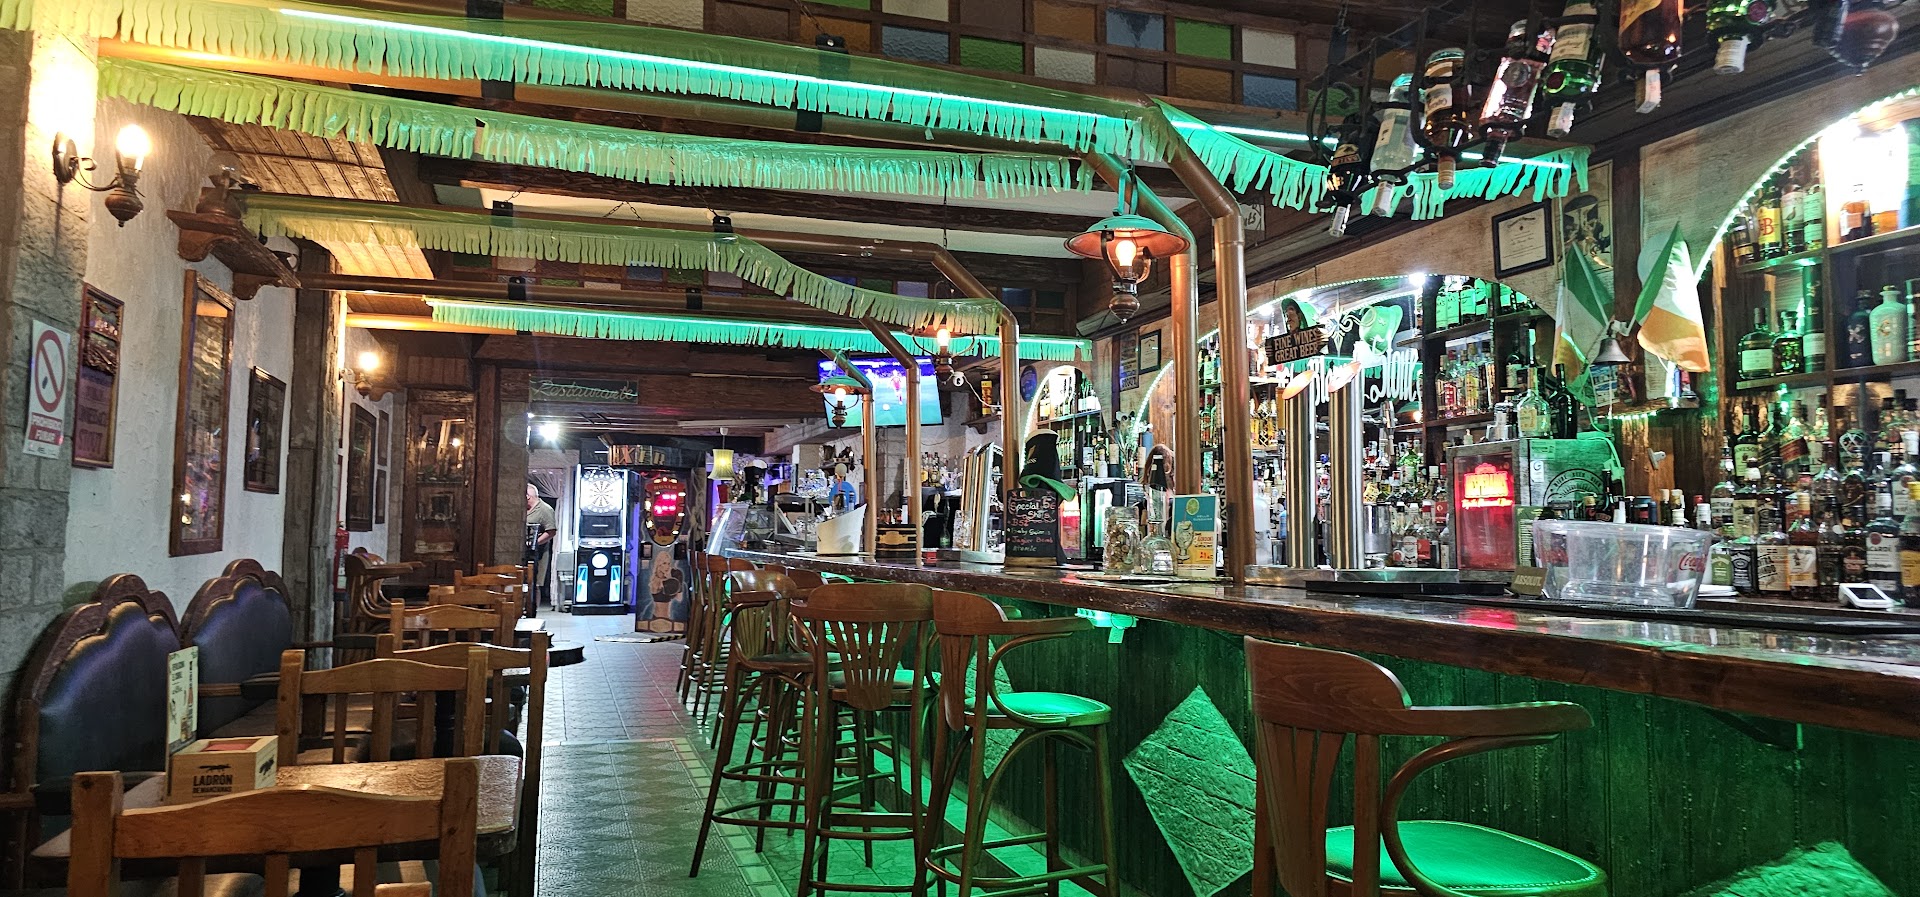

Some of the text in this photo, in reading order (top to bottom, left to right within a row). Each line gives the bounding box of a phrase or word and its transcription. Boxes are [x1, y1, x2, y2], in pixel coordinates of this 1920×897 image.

[1274, 329, 1318, 350] FINE WINES
[1275, 342, 1318, 362] GREAT BEER
[530, 380, 634, 400] Restaurante
[1219, 461, 1227, 533] MAGNERS
[1010, 501, 1040, 514] Special
[193, 773, 233, 786] LADRÓN
